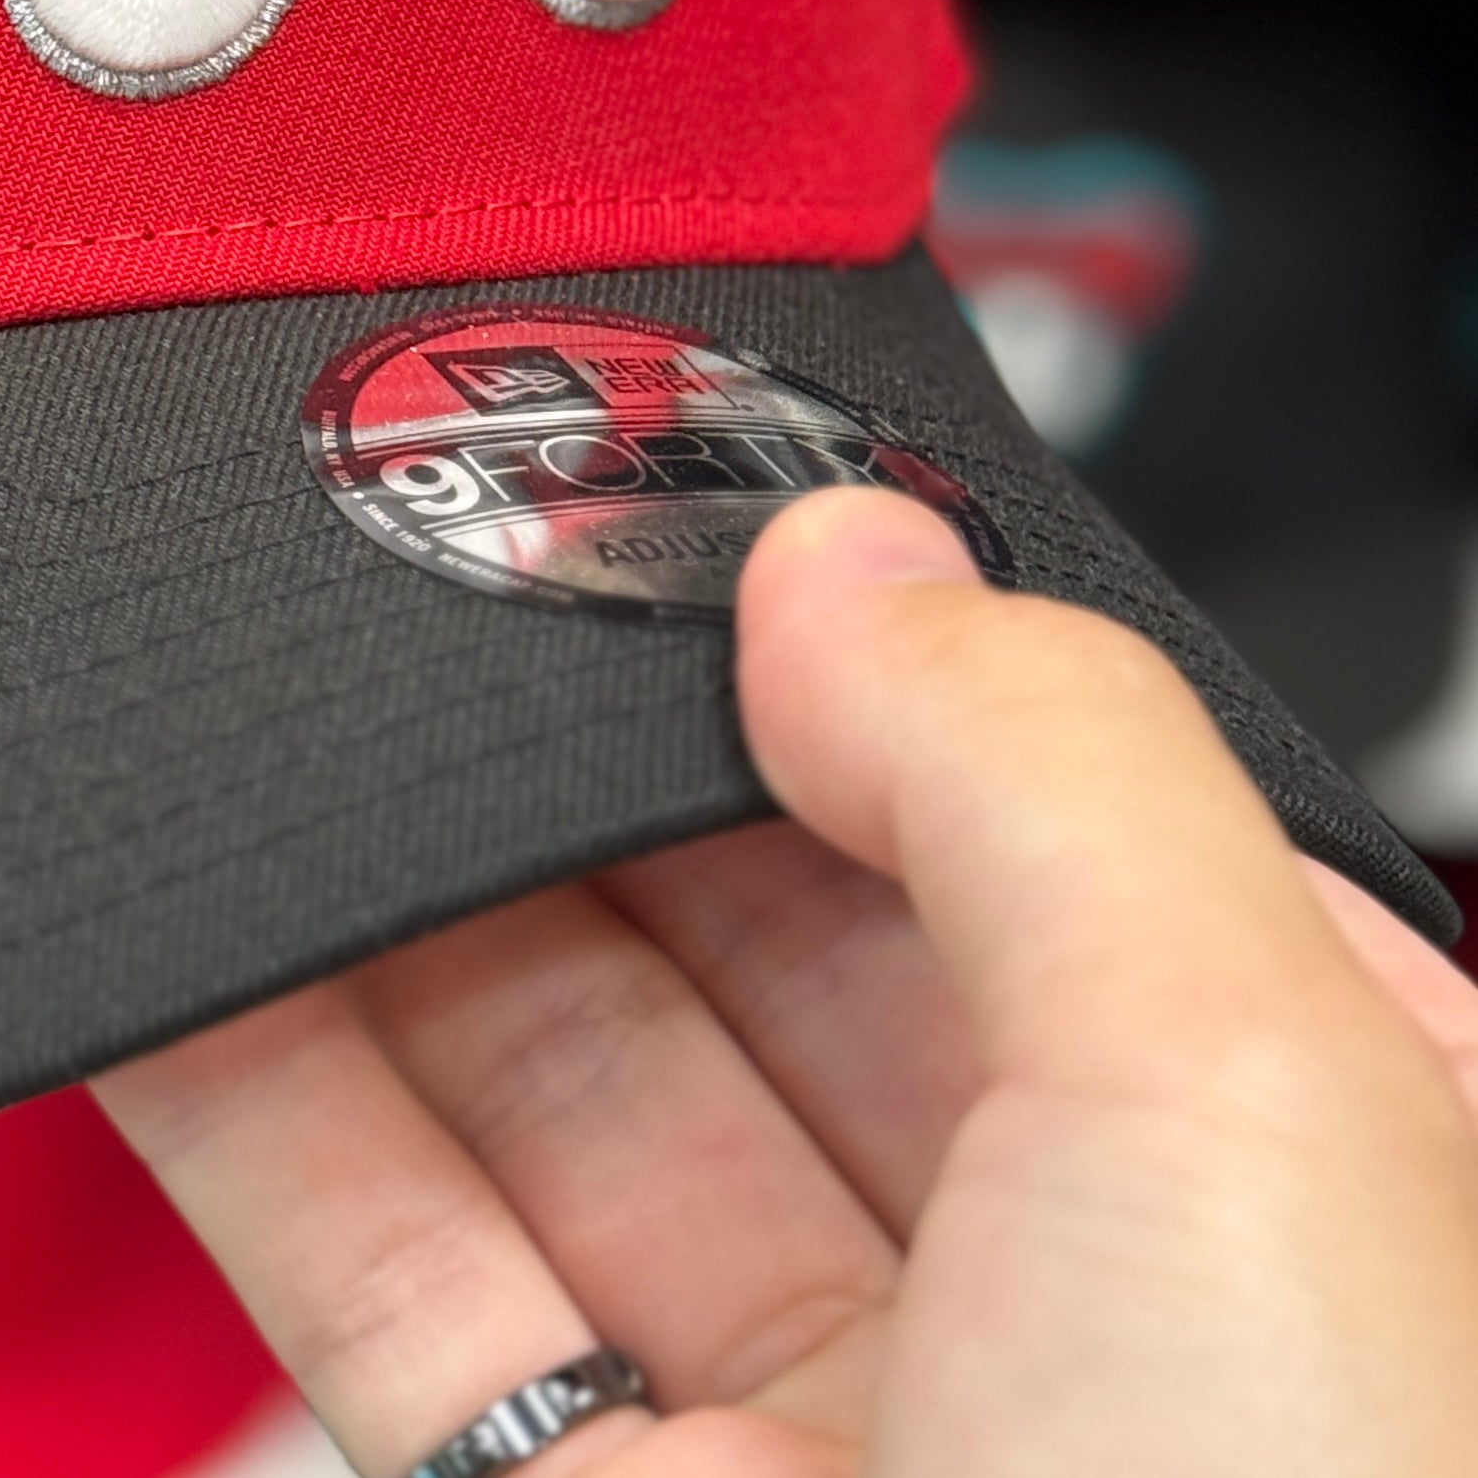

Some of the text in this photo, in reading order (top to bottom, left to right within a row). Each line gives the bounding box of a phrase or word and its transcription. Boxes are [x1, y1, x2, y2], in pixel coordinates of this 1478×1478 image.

[585, 358, 685, 376] NEW
[605, 376, 706, 394] ERA
[362, 504, 399, 532] SINCE
[395, 530, 432, 553] 1920
[595, 529, 756, 567] ADJUS
